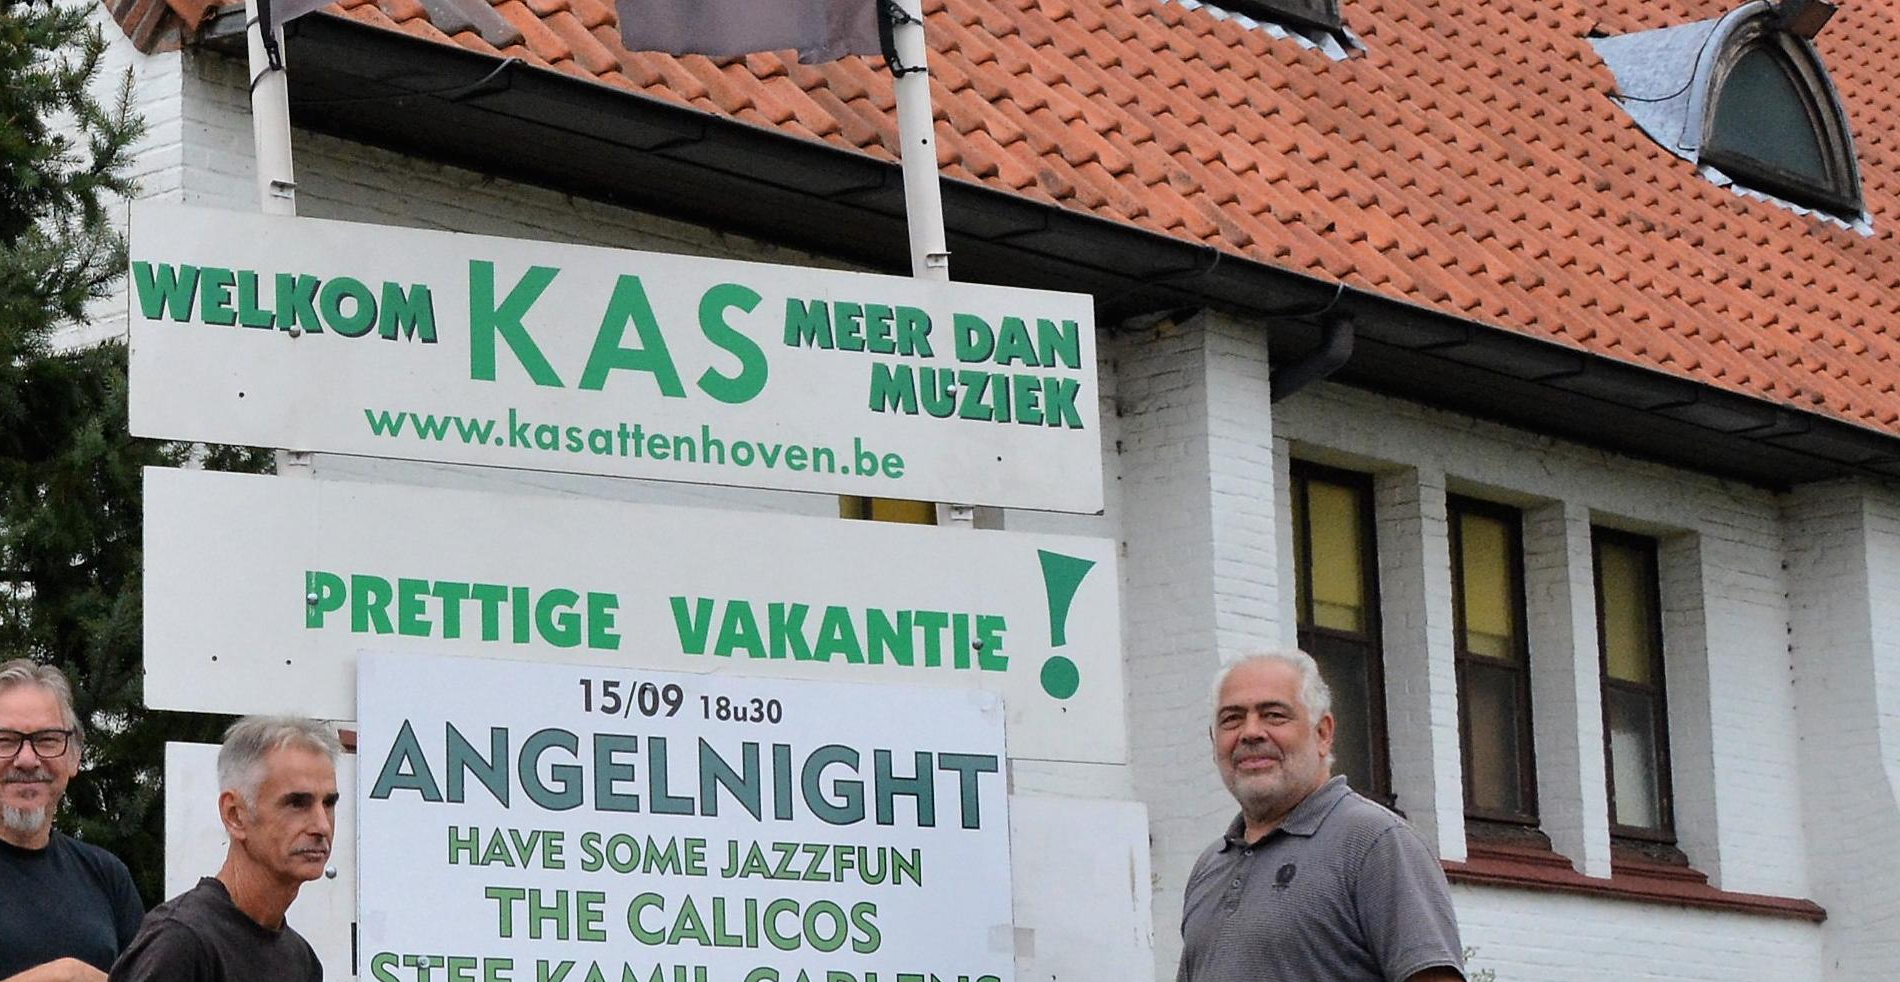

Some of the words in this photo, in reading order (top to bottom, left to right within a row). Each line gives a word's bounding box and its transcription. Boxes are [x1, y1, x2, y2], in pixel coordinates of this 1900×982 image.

[133, 262, 437, 343] WELKOM
[470, 259, 770, 404] KAS
[784, 299, 934, 357] MEER
[954, 314, 1081, 369] DAN
[869, 362, 1083, 429] MUZIEK
[364, 407, 906, 480] www.kasattenhoven.be
[306, 572, 620, 650] PRETTIGE
[671, 597, 1009, 671] VAKANTIE
[580, 679, 683, 718] 15/09
[701, 696, 782, 723] 18u30
[370, 718, 998, 829] ANGELNIGHT
[449, 826, 564, 869] HAVE
[581, 833, 707, 875] SOME
[721, 841, 921, 886] JAZZFUN
[485, 887, 606, 941] THE
[628, 893, 881, 953] CALICOS
